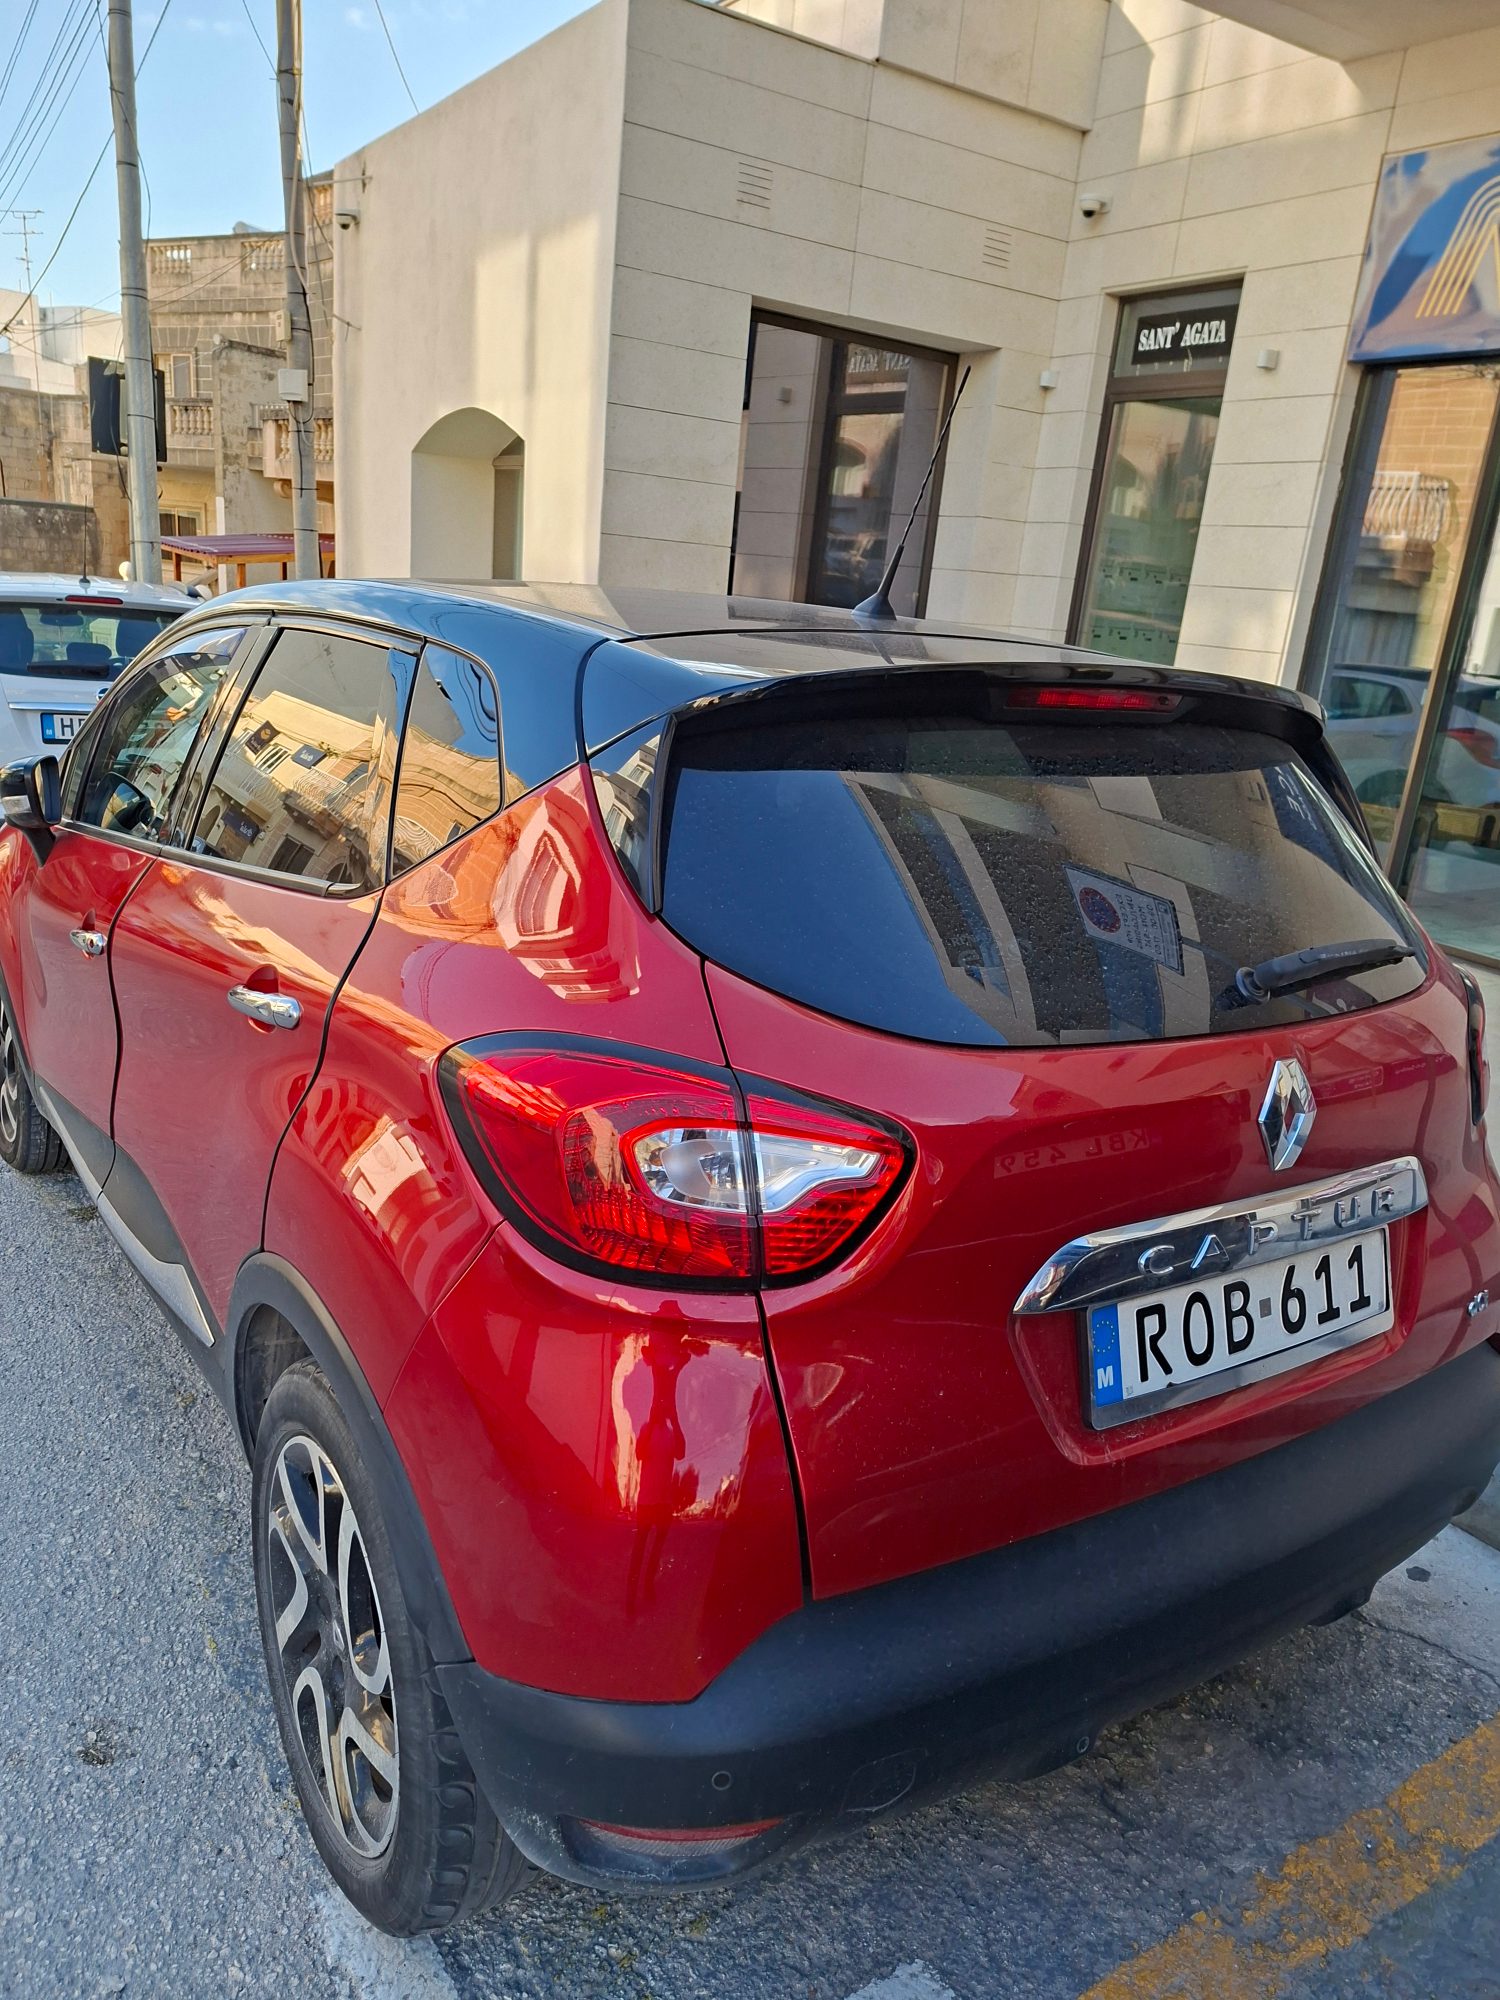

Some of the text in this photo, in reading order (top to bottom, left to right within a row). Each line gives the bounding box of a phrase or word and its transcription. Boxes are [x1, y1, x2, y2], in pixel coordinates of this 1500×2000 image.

[1138, 320, 1226, 351] SANT' AGATA
[1137, 1185, 1395, 1276] CAPTUR
[1097, 1365, 1114, 1389] M
